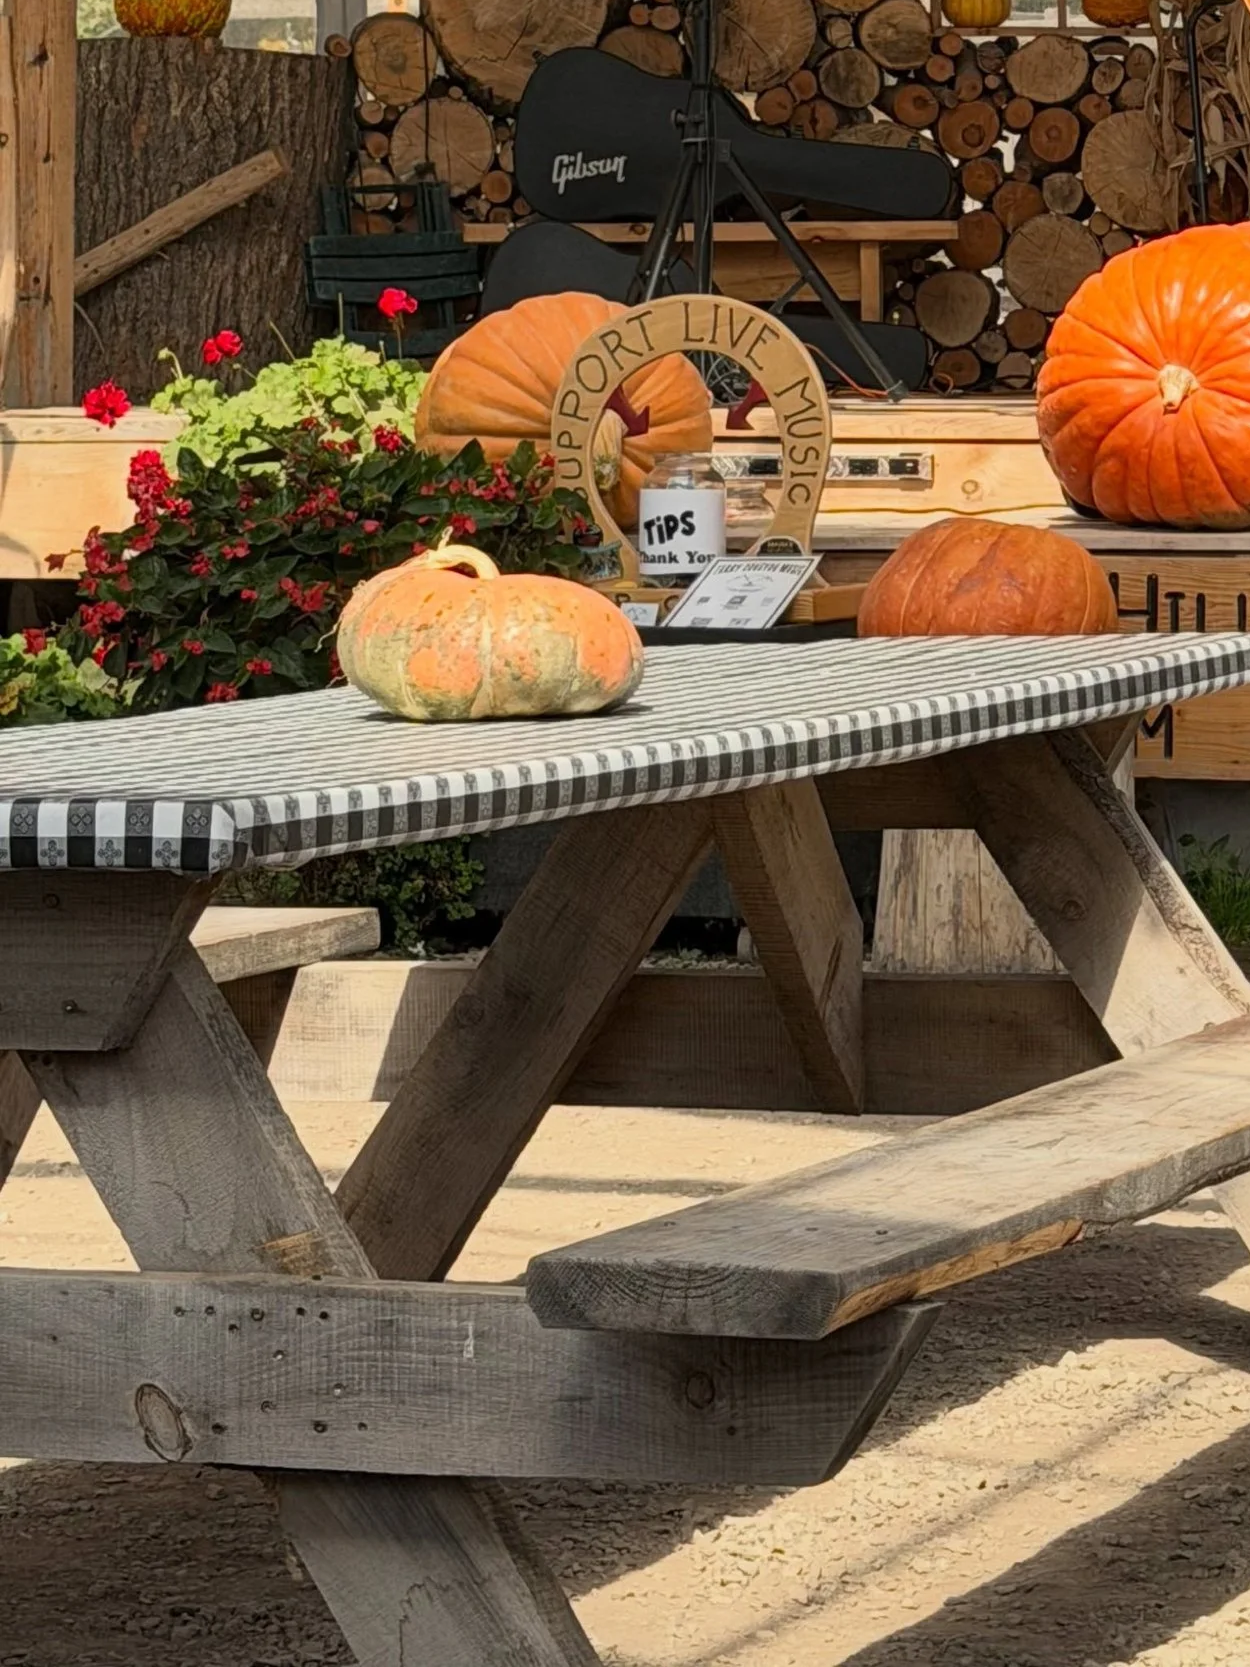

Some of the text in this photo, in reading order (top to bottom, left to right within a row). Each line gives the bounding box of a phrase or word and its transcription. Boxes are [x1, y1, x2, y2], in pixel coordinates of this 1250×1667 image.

[551, 151, 629, 195] Gibson
[556, 301, 824, 506] UPPORT LIVE MUSIC
